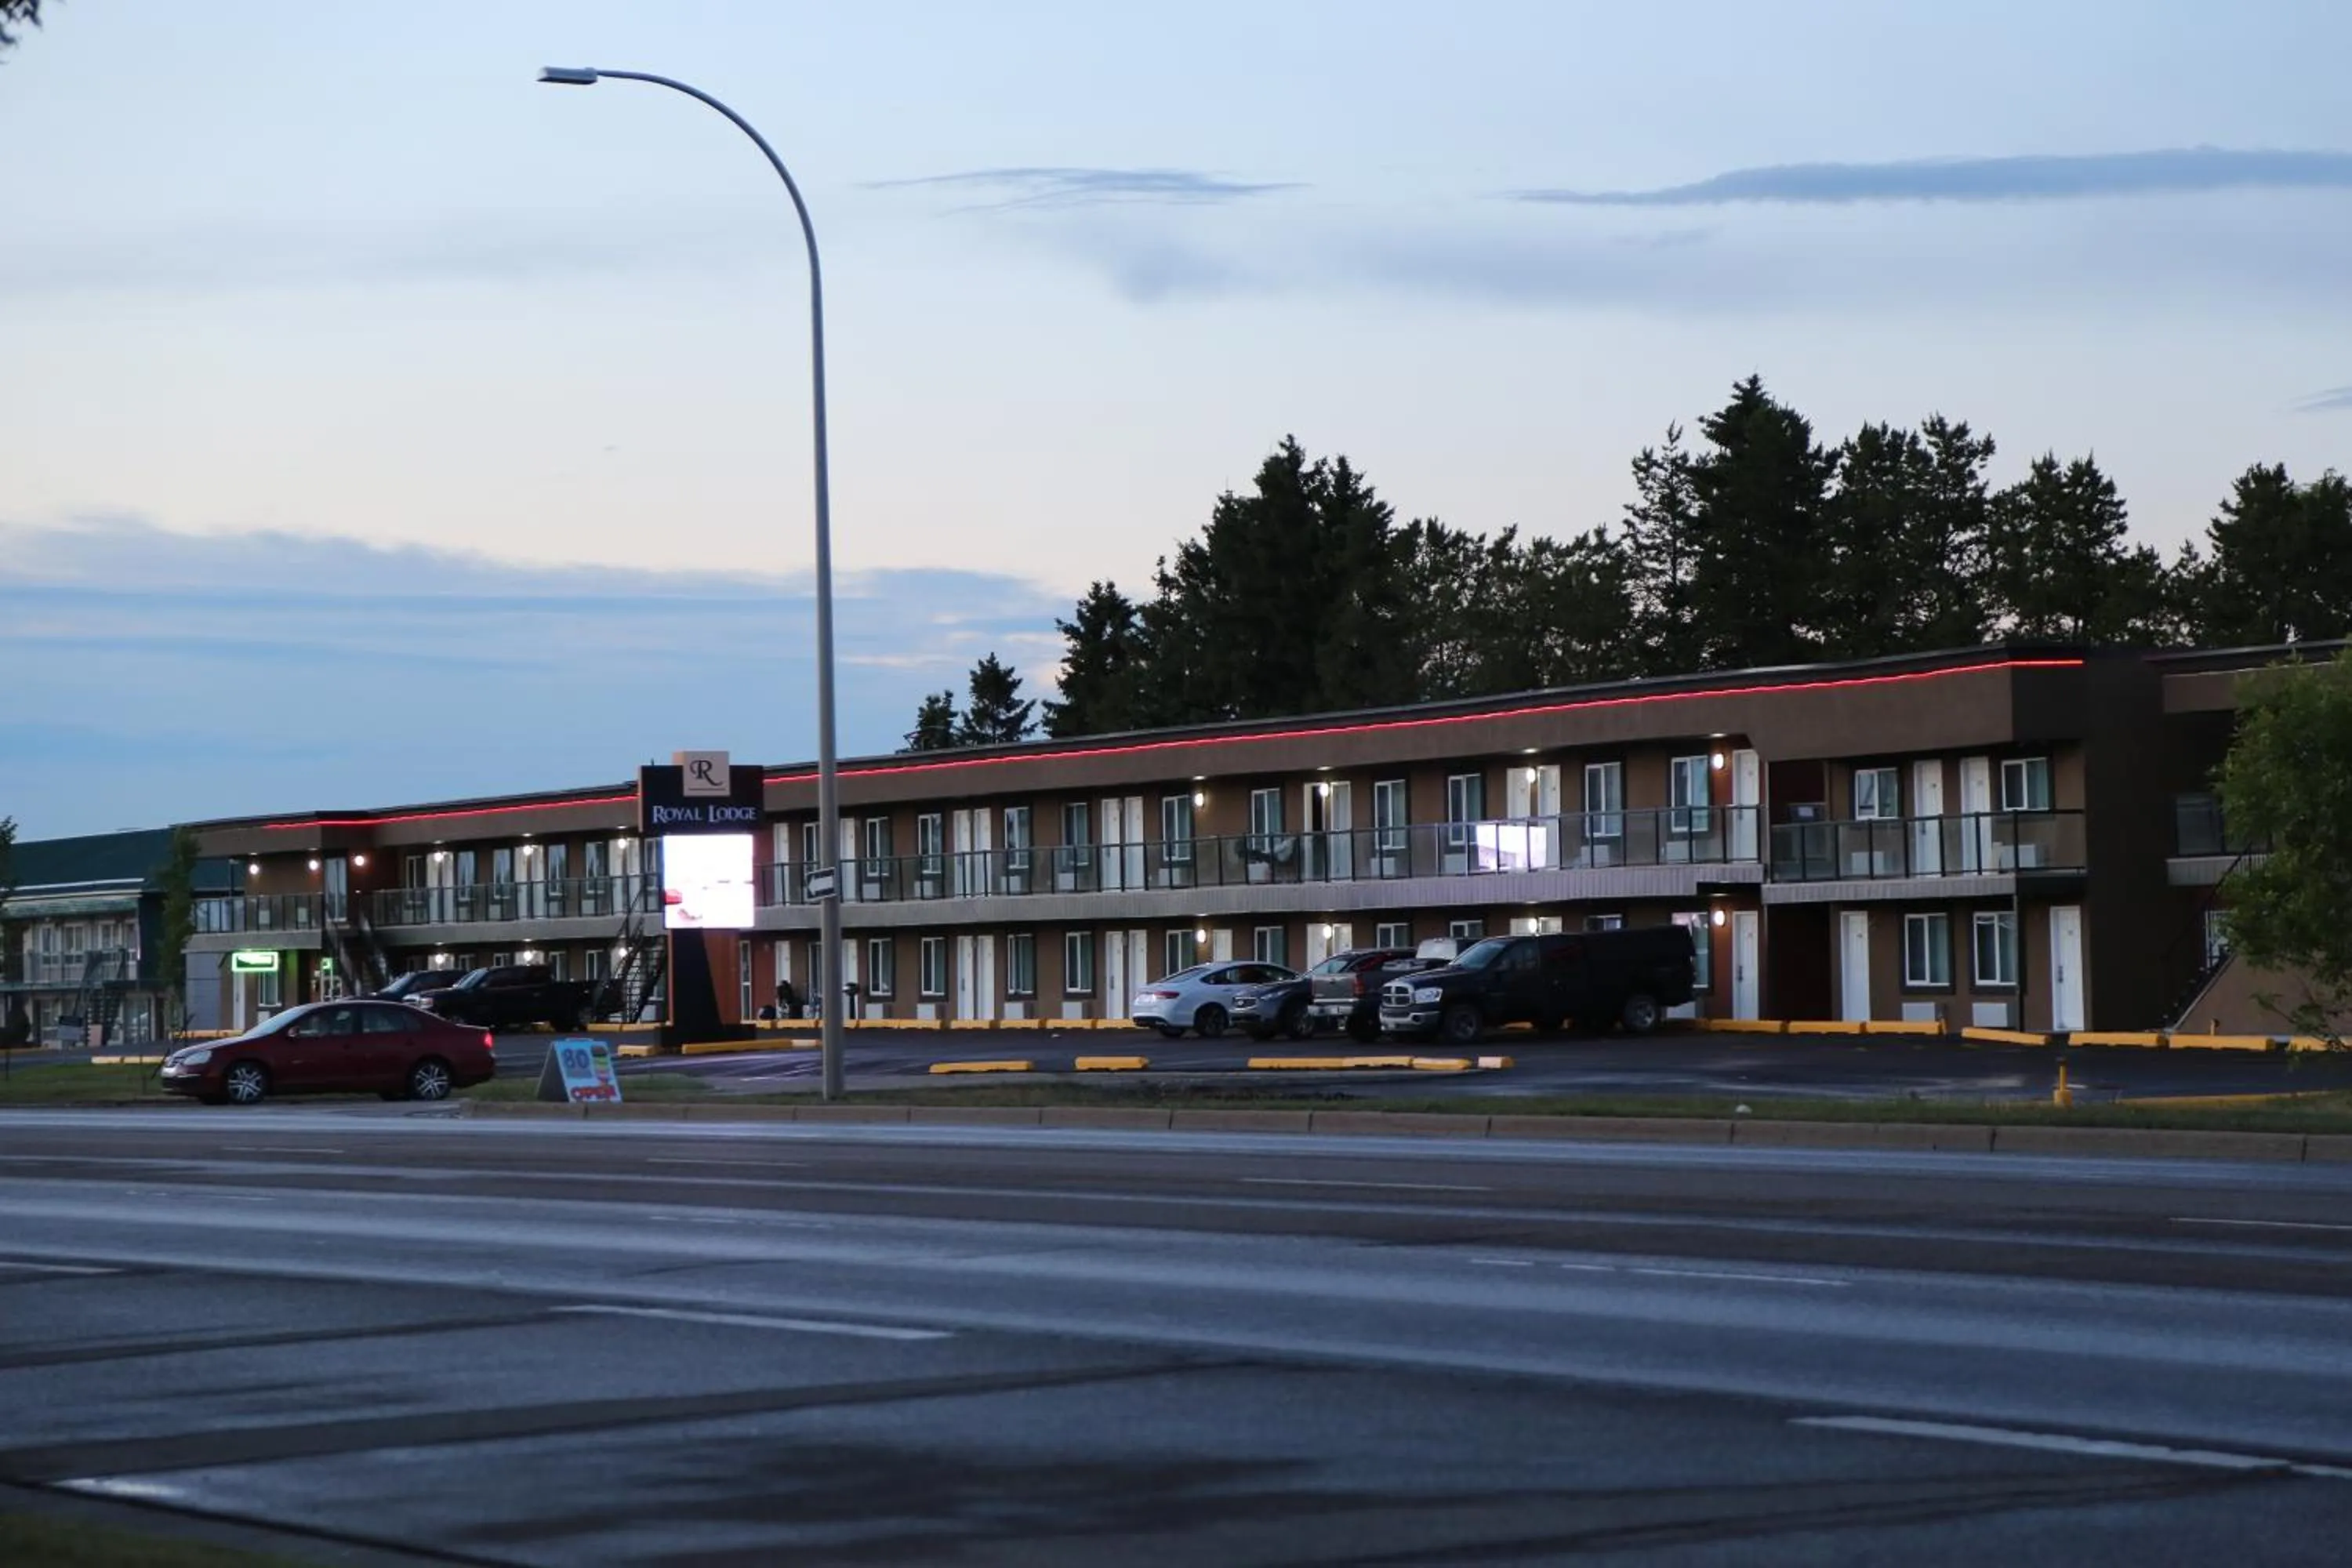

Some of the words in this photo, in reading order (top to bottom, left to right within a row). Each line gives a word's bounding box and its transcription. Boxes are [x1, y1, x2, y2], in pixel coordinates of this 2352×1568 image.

[689, 759, 723, 786] R
[652, 804, 703, 823] ROYAL
[708, 804, 758, 823] LODGE
